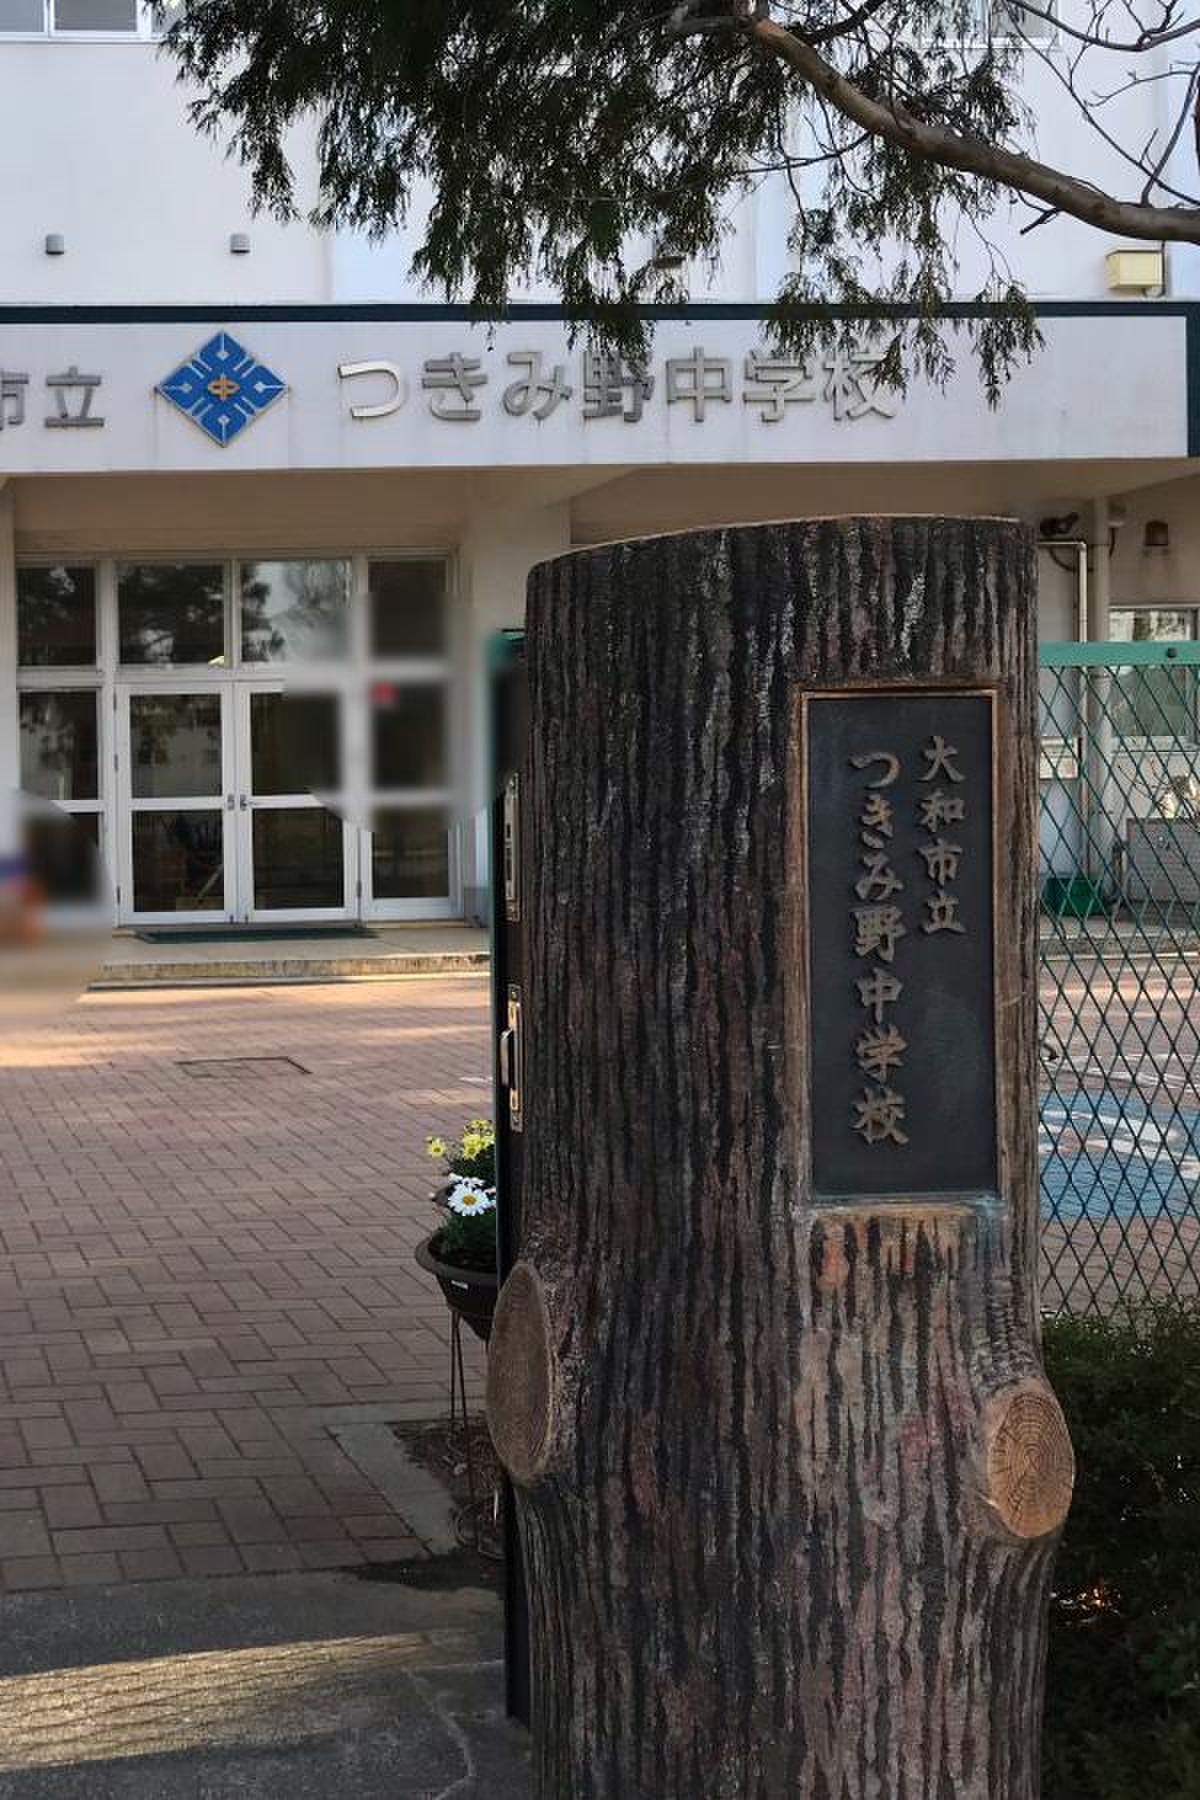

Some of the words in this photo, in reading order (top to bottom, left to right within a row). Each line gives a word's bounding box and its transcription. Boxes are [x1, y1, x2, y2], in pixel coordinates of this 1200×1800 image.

[337, 346, 898, 423] つきみ野中学校
[918, 735, 966, 935] 大和市立
[849, 751, 909, 1145] つきみ野中学校
